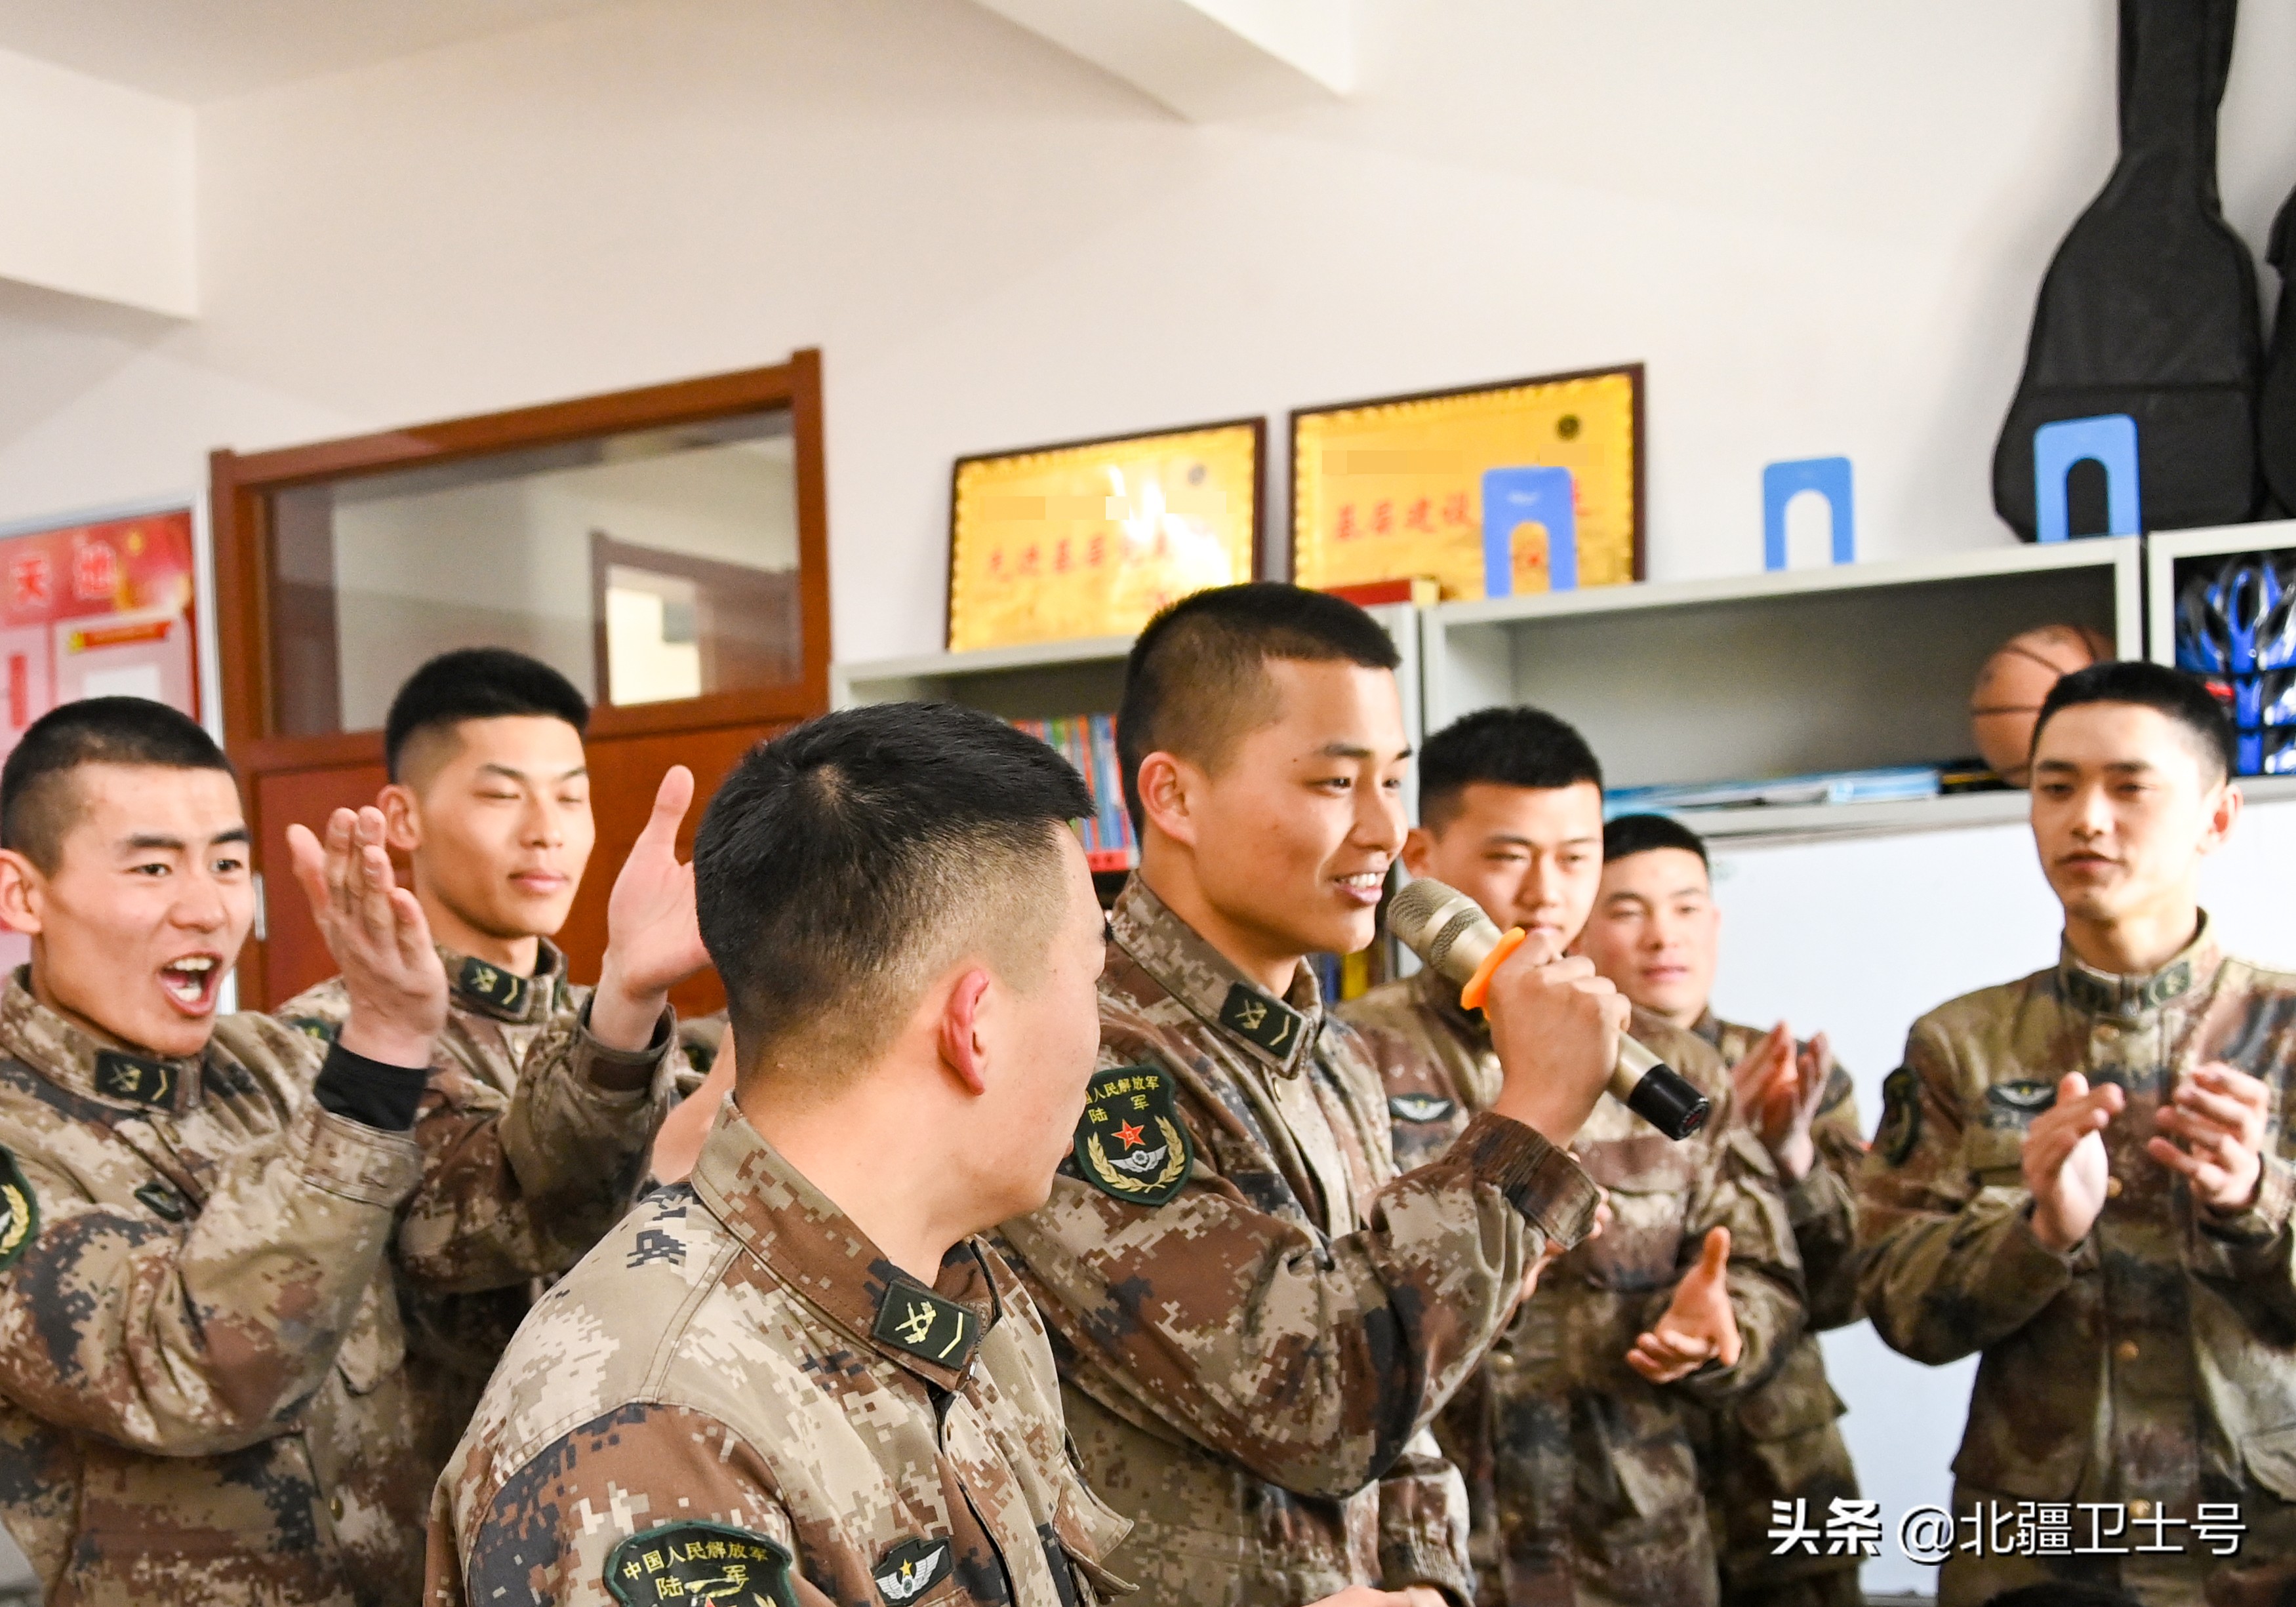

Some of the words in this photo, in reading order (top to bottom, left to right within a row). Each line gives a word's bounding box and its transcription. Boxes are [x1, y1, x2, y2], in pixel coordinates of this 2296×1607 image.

[623, 1541, 769, 1581] 中国人民解放军
